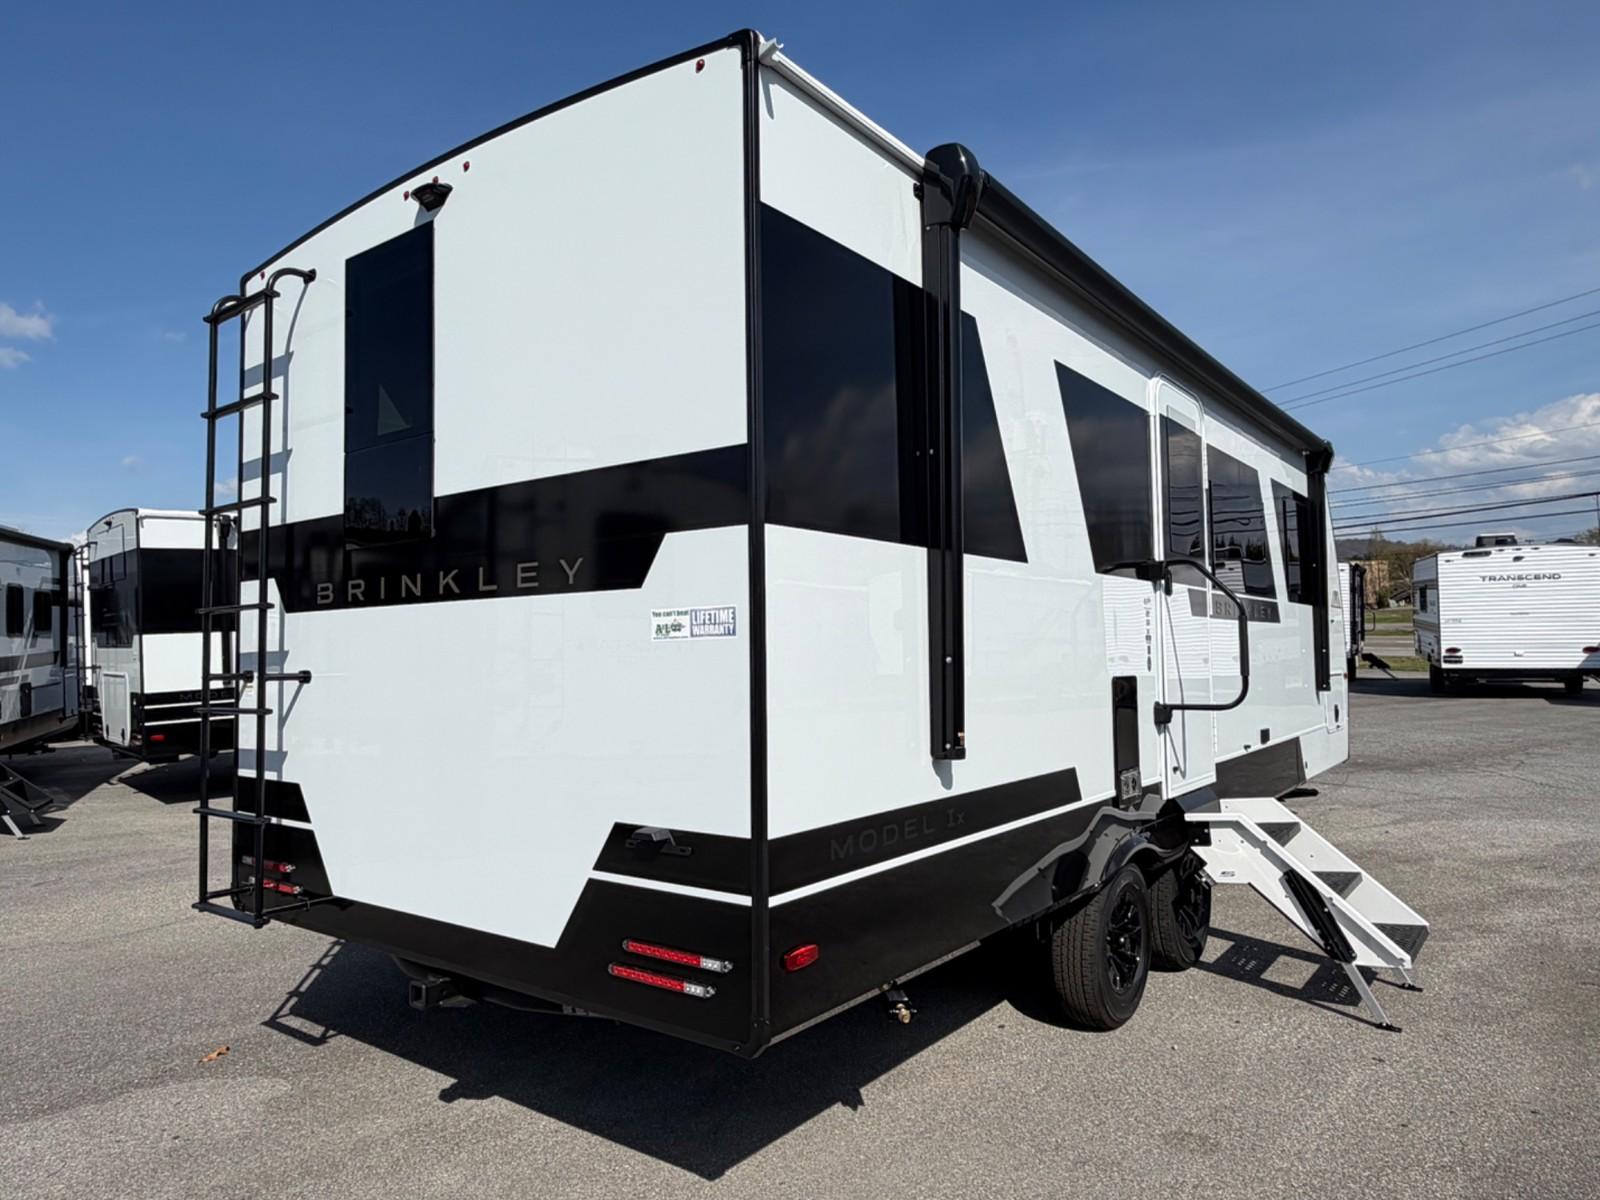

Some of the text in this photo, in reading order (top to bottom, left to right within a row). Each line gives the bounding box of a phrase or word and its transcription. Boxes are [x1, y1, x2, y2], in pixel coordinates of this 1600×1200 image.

[317, 557, 583, 604] BRINKLEY
[1480, 573, 1561, 583] TRANSCEND
[691, 608, 735, 625] LIFETIME
[1214, 600, 1273, 619] BRILEY
[691, 624, 735, 635] WARRANTY
[830, 815, 936, 862] MODEL
